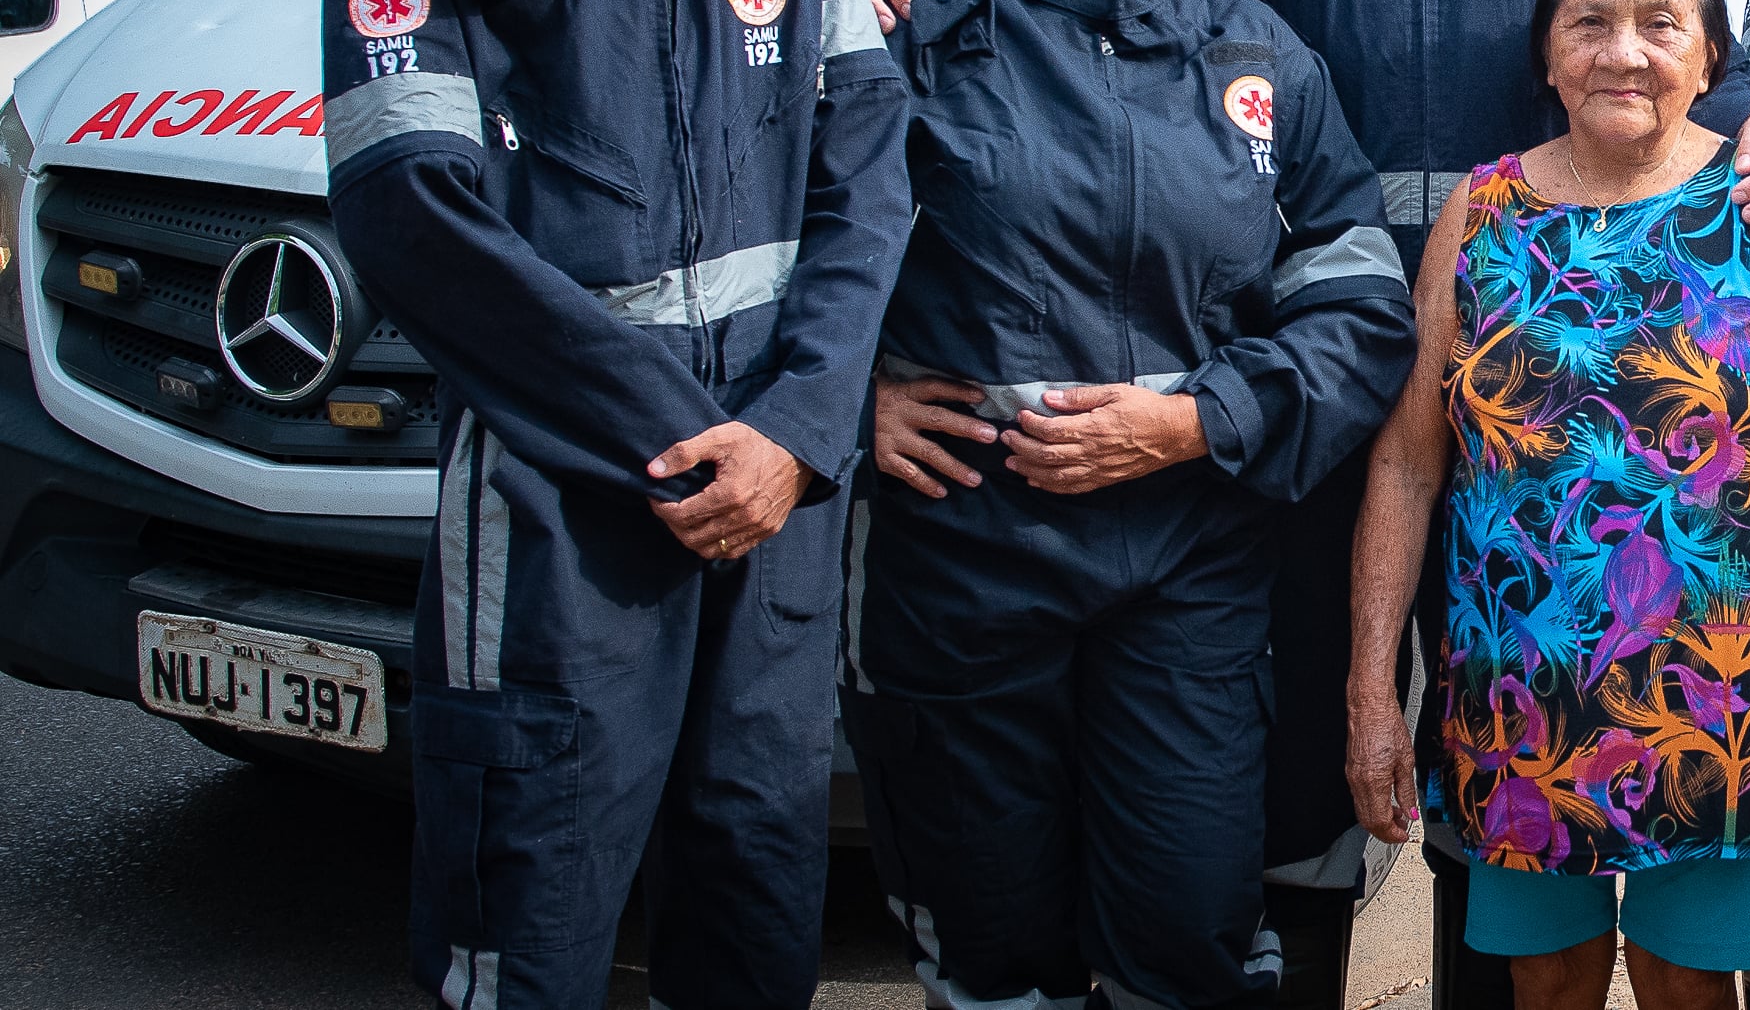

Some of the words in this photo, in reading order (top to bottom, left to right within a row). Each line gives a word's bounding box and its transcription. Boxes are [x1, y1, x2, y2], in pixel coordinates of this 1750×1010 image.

[365, 35, 415, 55] SAMU
[743, 25, 779, 45] SAMU
[367, 48, 420, 78] 192
[744, 41, 783, 67] 192
